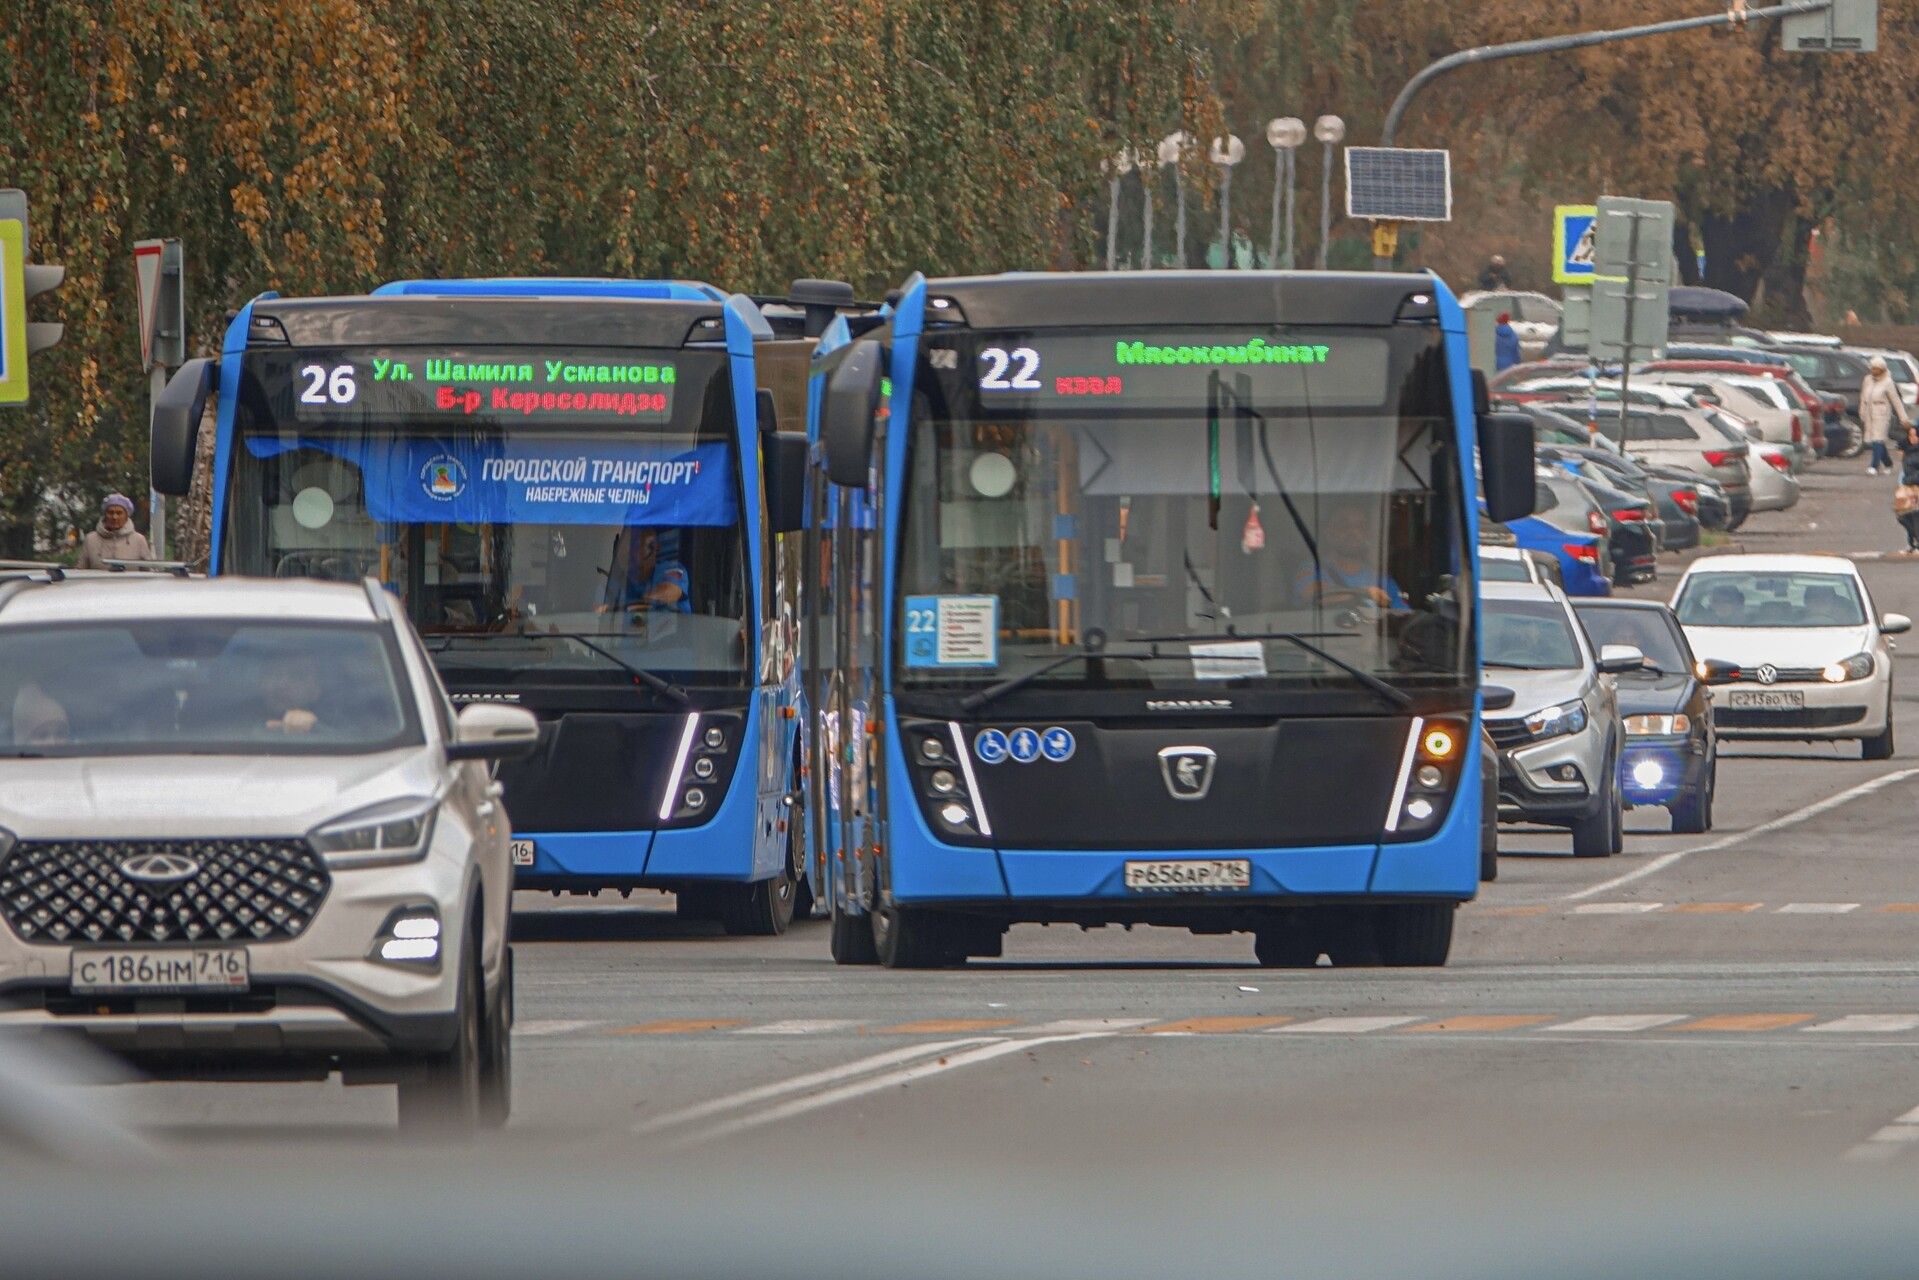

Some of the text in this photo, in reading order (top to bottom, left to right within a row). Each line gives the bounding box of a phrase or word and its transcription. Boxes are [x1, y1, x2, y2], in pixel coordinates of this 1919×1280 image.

[1116, 338, 1330, 364] Мясокомбинат
[373, 359, 676, 384] Ул. Шамиля Усманова
[980, 348, 1042, 389] 22
[301, 365, 355, 403] 26
[436, 386, 482, 413] Б-р
[482, 457, 587, 484] ГОРОДСКОЙ
[591, 460, 694, 486] ТРАНСПОРТ
[525, 487, 651, 504] НАБЕРЕЖНЫЕ ЧЕЛНЫ
[907, 610, 935, 632] 22
[511, 843, 528, 857] 16
[198, 952, 239, 974] 716
